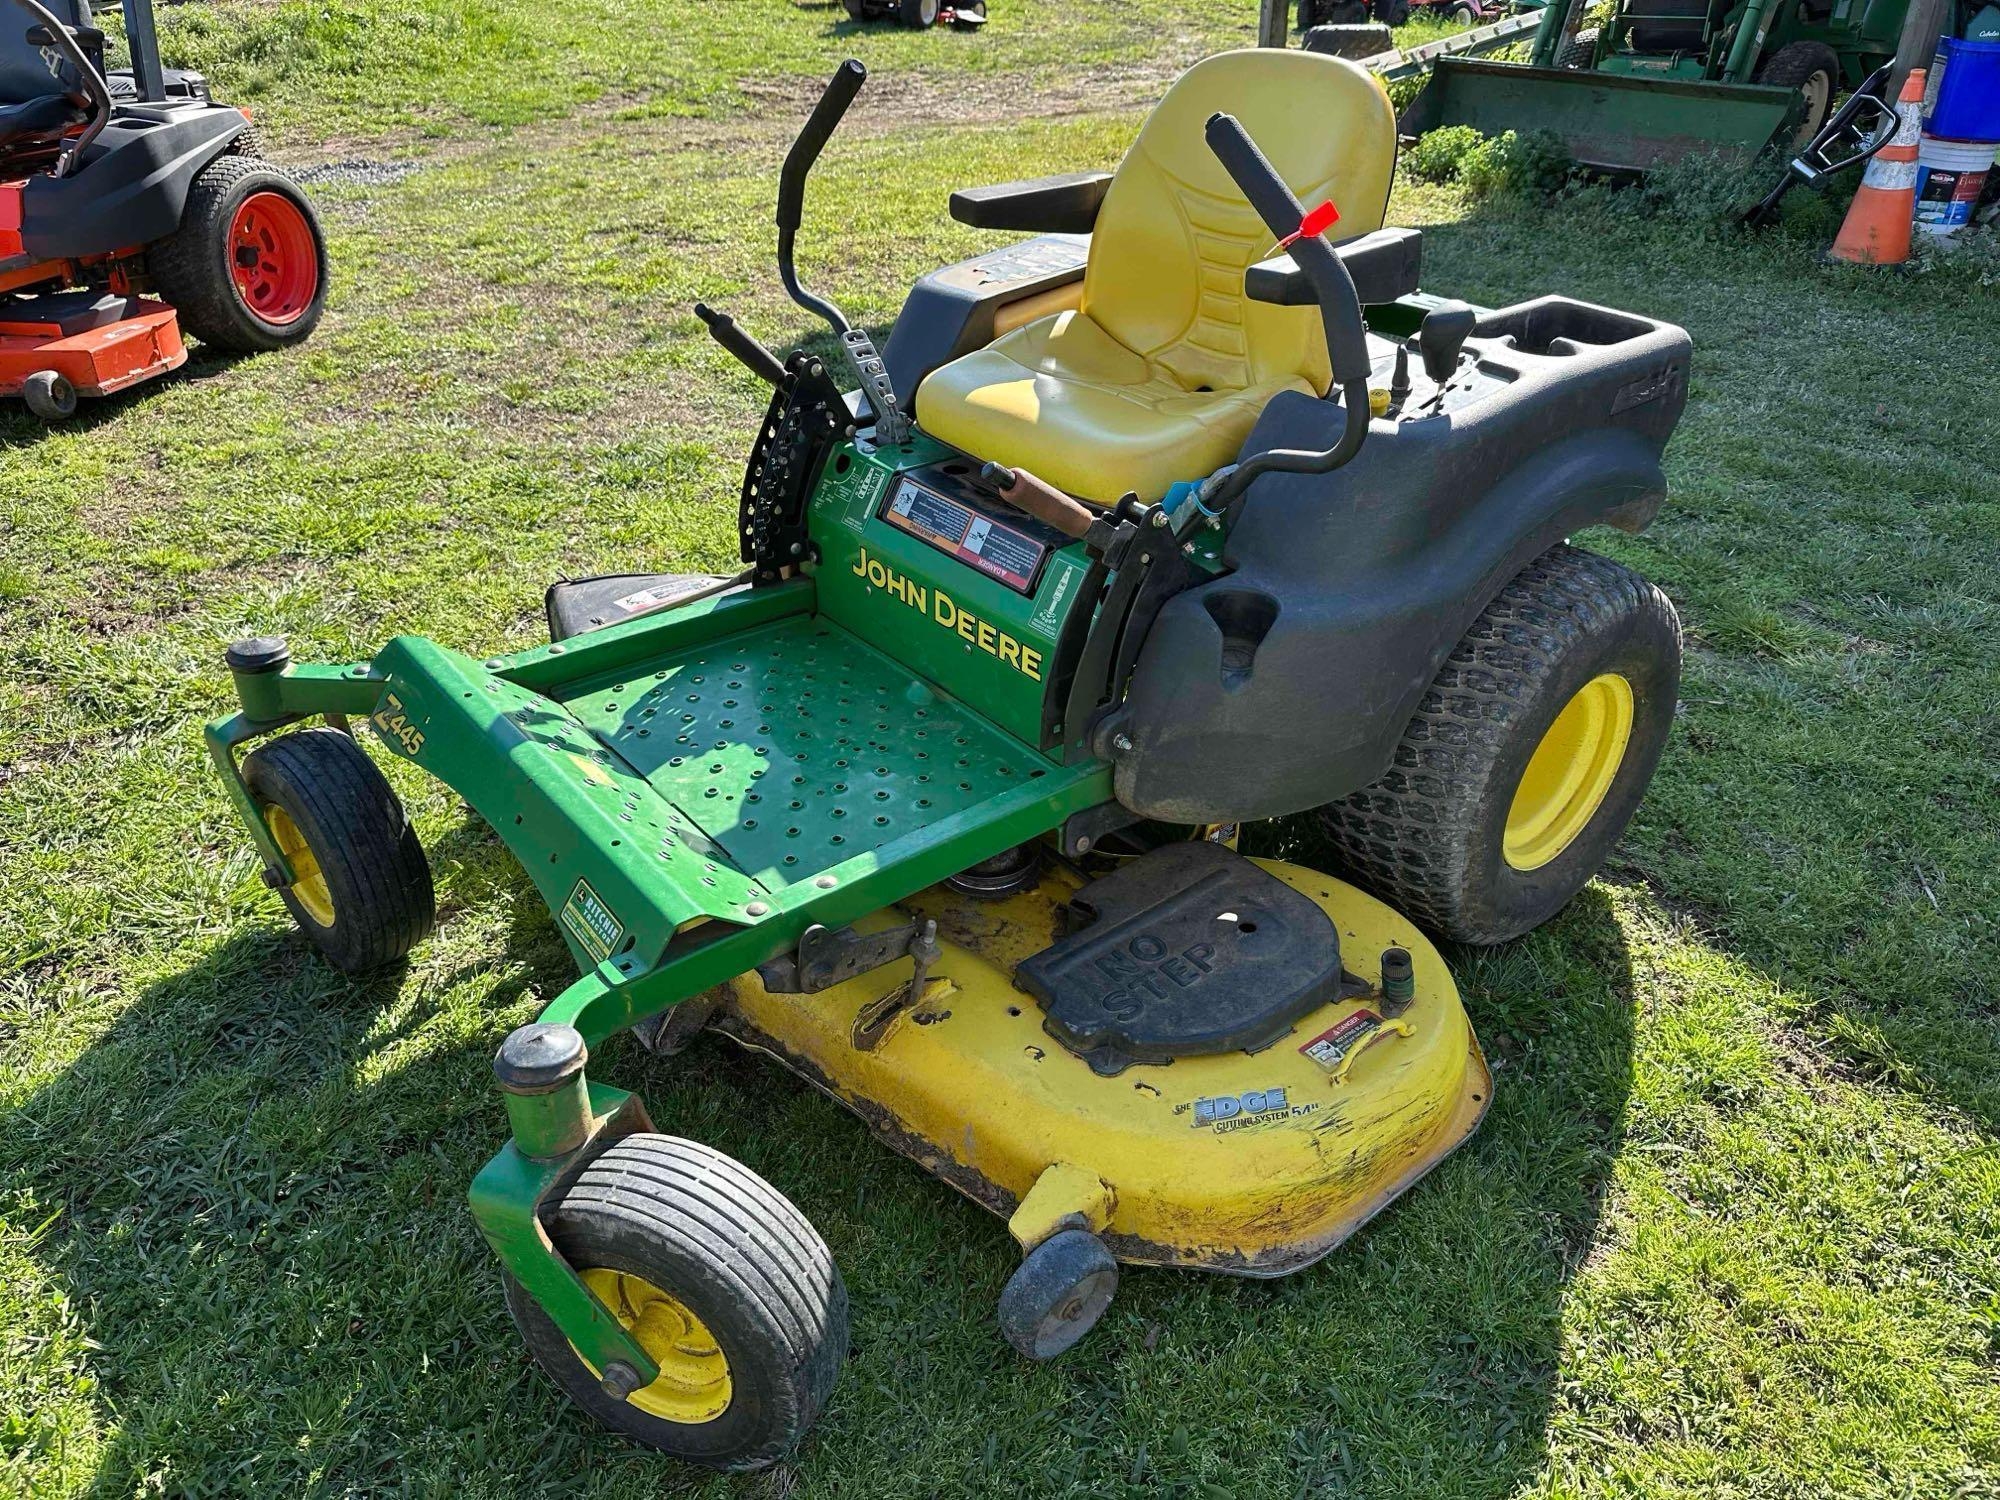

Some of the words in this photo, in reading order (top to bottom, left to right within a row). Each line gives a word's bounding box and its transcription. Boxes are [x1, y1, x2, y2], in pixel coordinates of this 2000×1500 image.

[909, 522, 933, 538] WARNING
[978, 558, 1002, 575] DANGER
[852, 547, 927, 615] JOHN
[934, 588, 1042, 683] DEERE
[373, 692, 426, 755] Z445
[583, 909, 611, 945] TRACTOR
[585, 897, 619, 940] RITCHIE
[1094, 935, 1168, 982] NO
[1101, 942, 1216, 1023] STEP
[1338, 1016, 1360, 1034] DANGER
[1194, 1087, 1287, 1122] EDGE
[1255, 1111, 1290, 1124] SYSTEM
